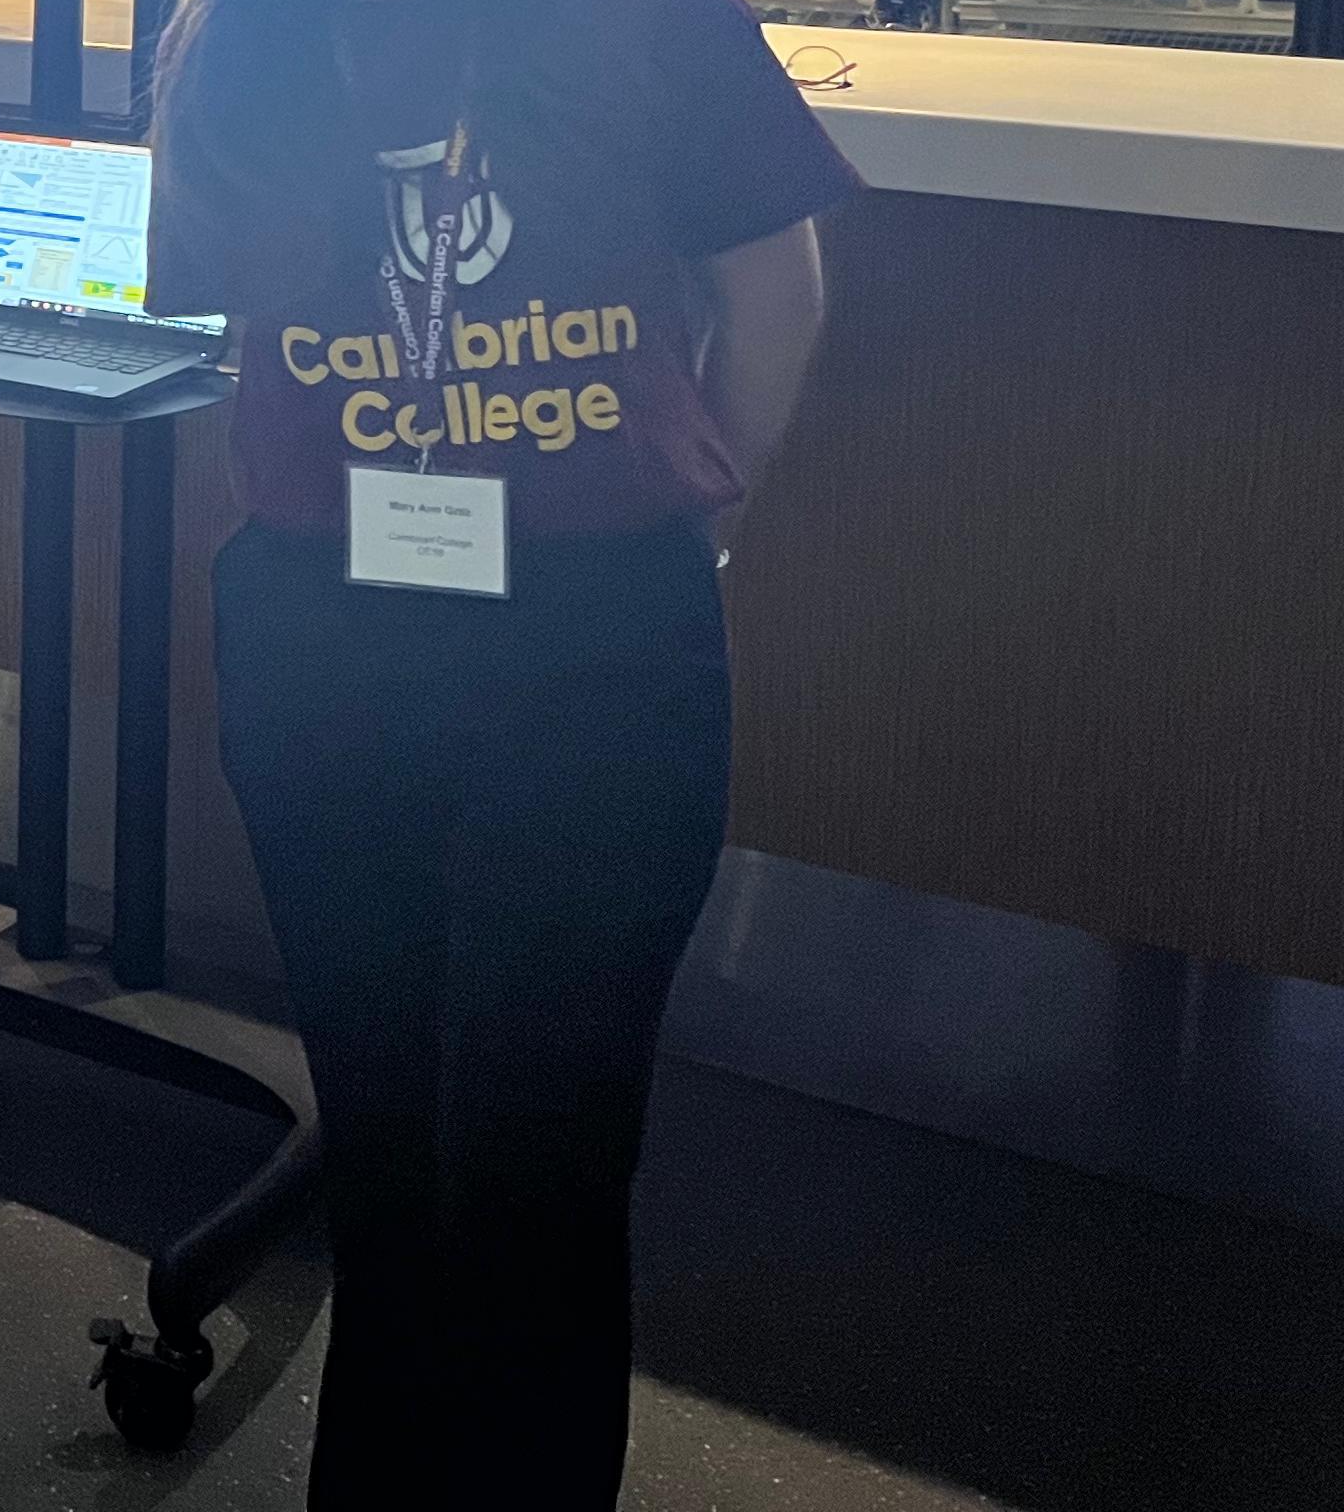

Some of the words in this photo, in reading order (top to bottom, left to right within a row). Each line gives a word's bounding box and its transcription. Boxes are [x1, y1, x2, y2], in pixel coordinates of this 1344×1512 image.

[430, 231, 452, 317] Cambrian
[387, 278, 421, 361] Cambrian
[421, 317, 444, 381] College
